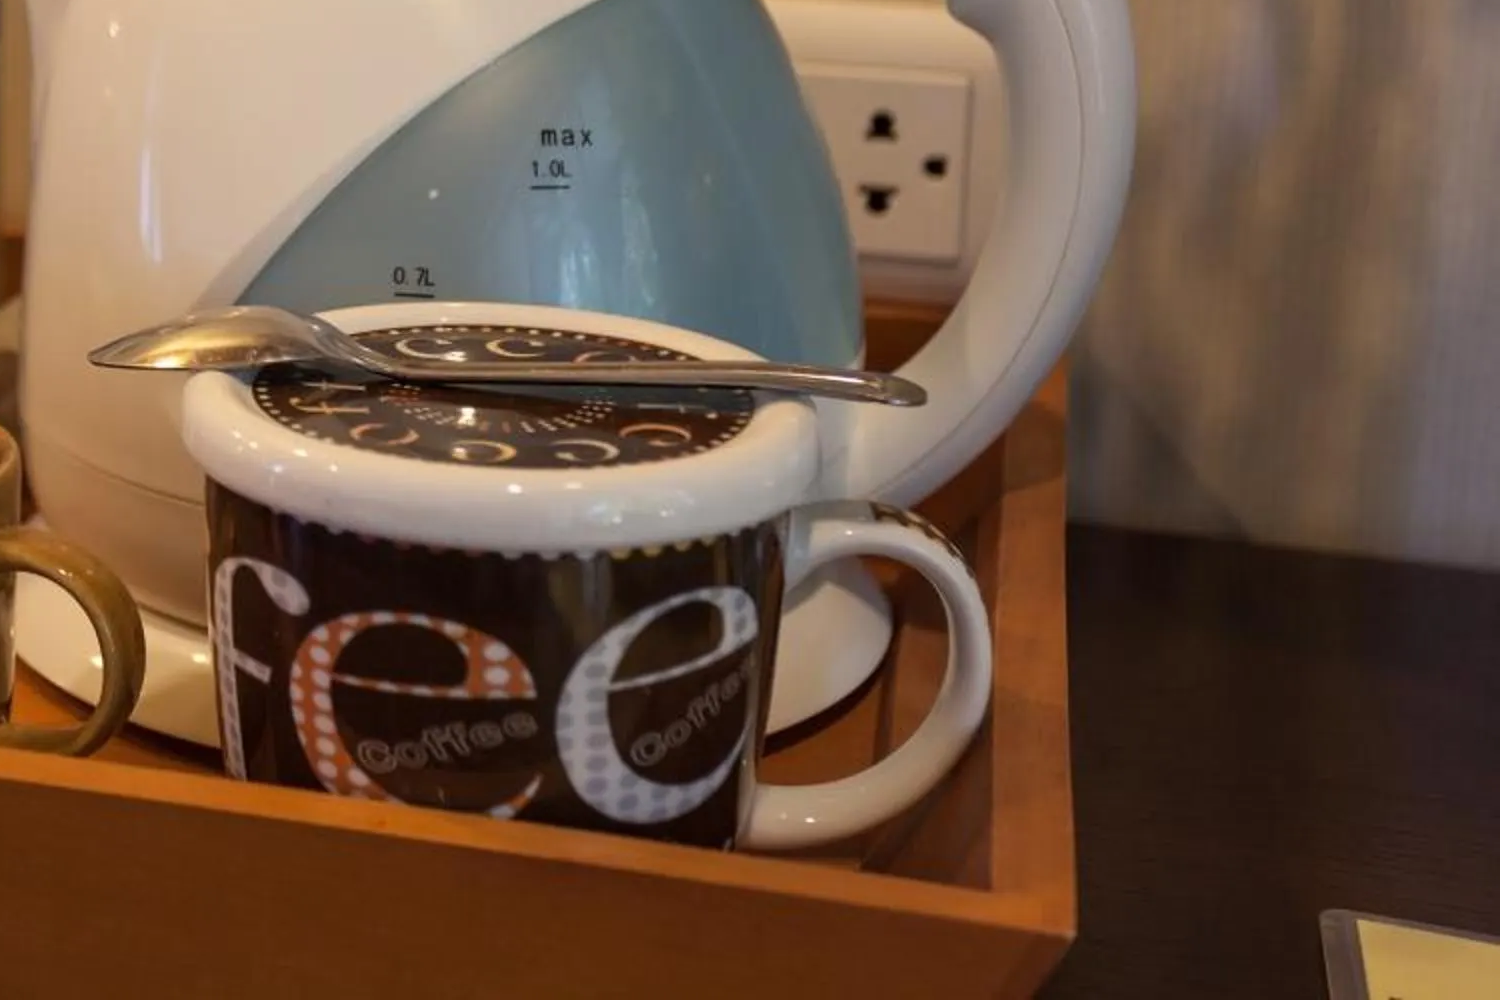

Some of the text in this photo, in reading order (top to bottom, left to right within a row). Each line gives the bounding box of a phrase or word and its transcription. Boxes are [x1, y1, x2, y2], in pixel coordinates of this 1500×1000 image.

[540, 128, 594, 148] max
[531, 159, 572, 179] 1.0L
[393, 266, 435, 287] 0.7L
[357, 711, 539, 774] Coffee
